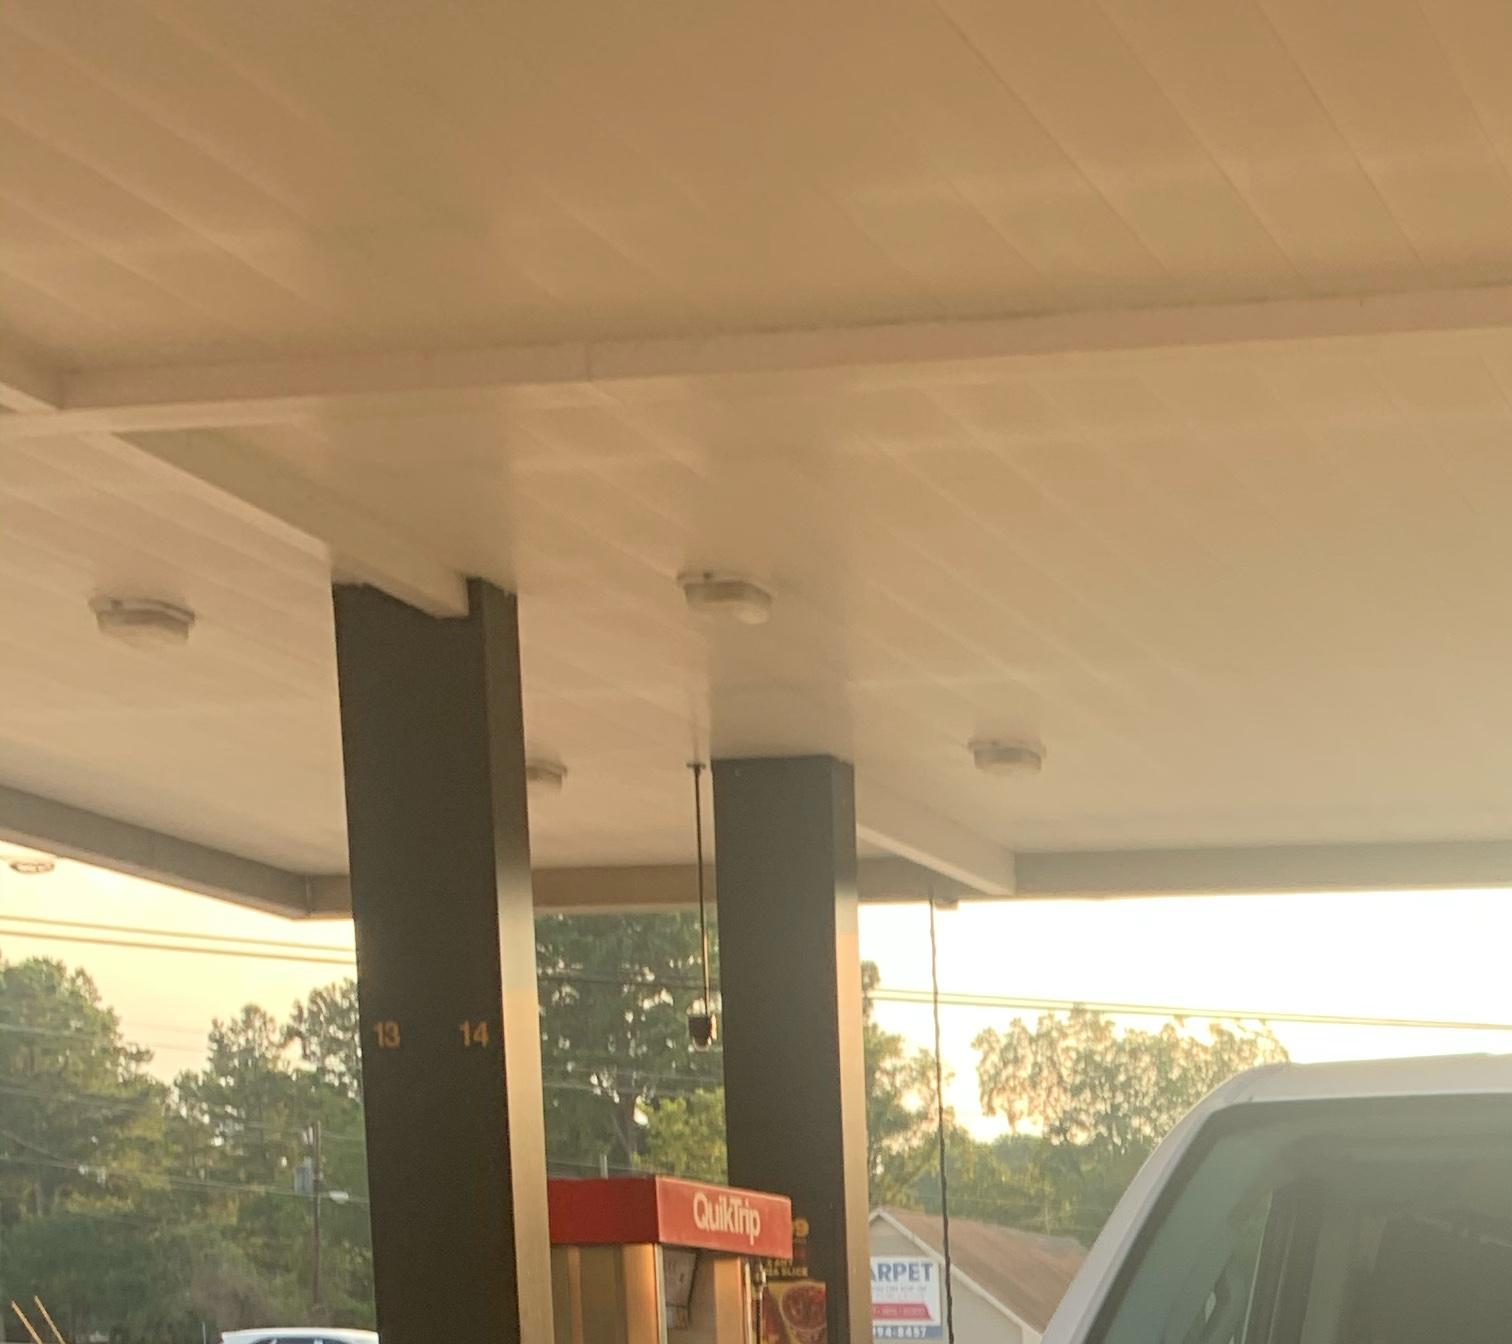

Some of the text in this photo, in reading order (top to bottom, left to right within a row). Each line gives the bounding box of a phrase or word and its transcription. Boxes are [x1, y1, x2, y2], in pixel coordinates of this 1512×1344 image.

[374, 1021, 400, 1049] 13
[459, 1020, 489, 1049] 14
[693, 1191, 761, 1247] QuikTrip
